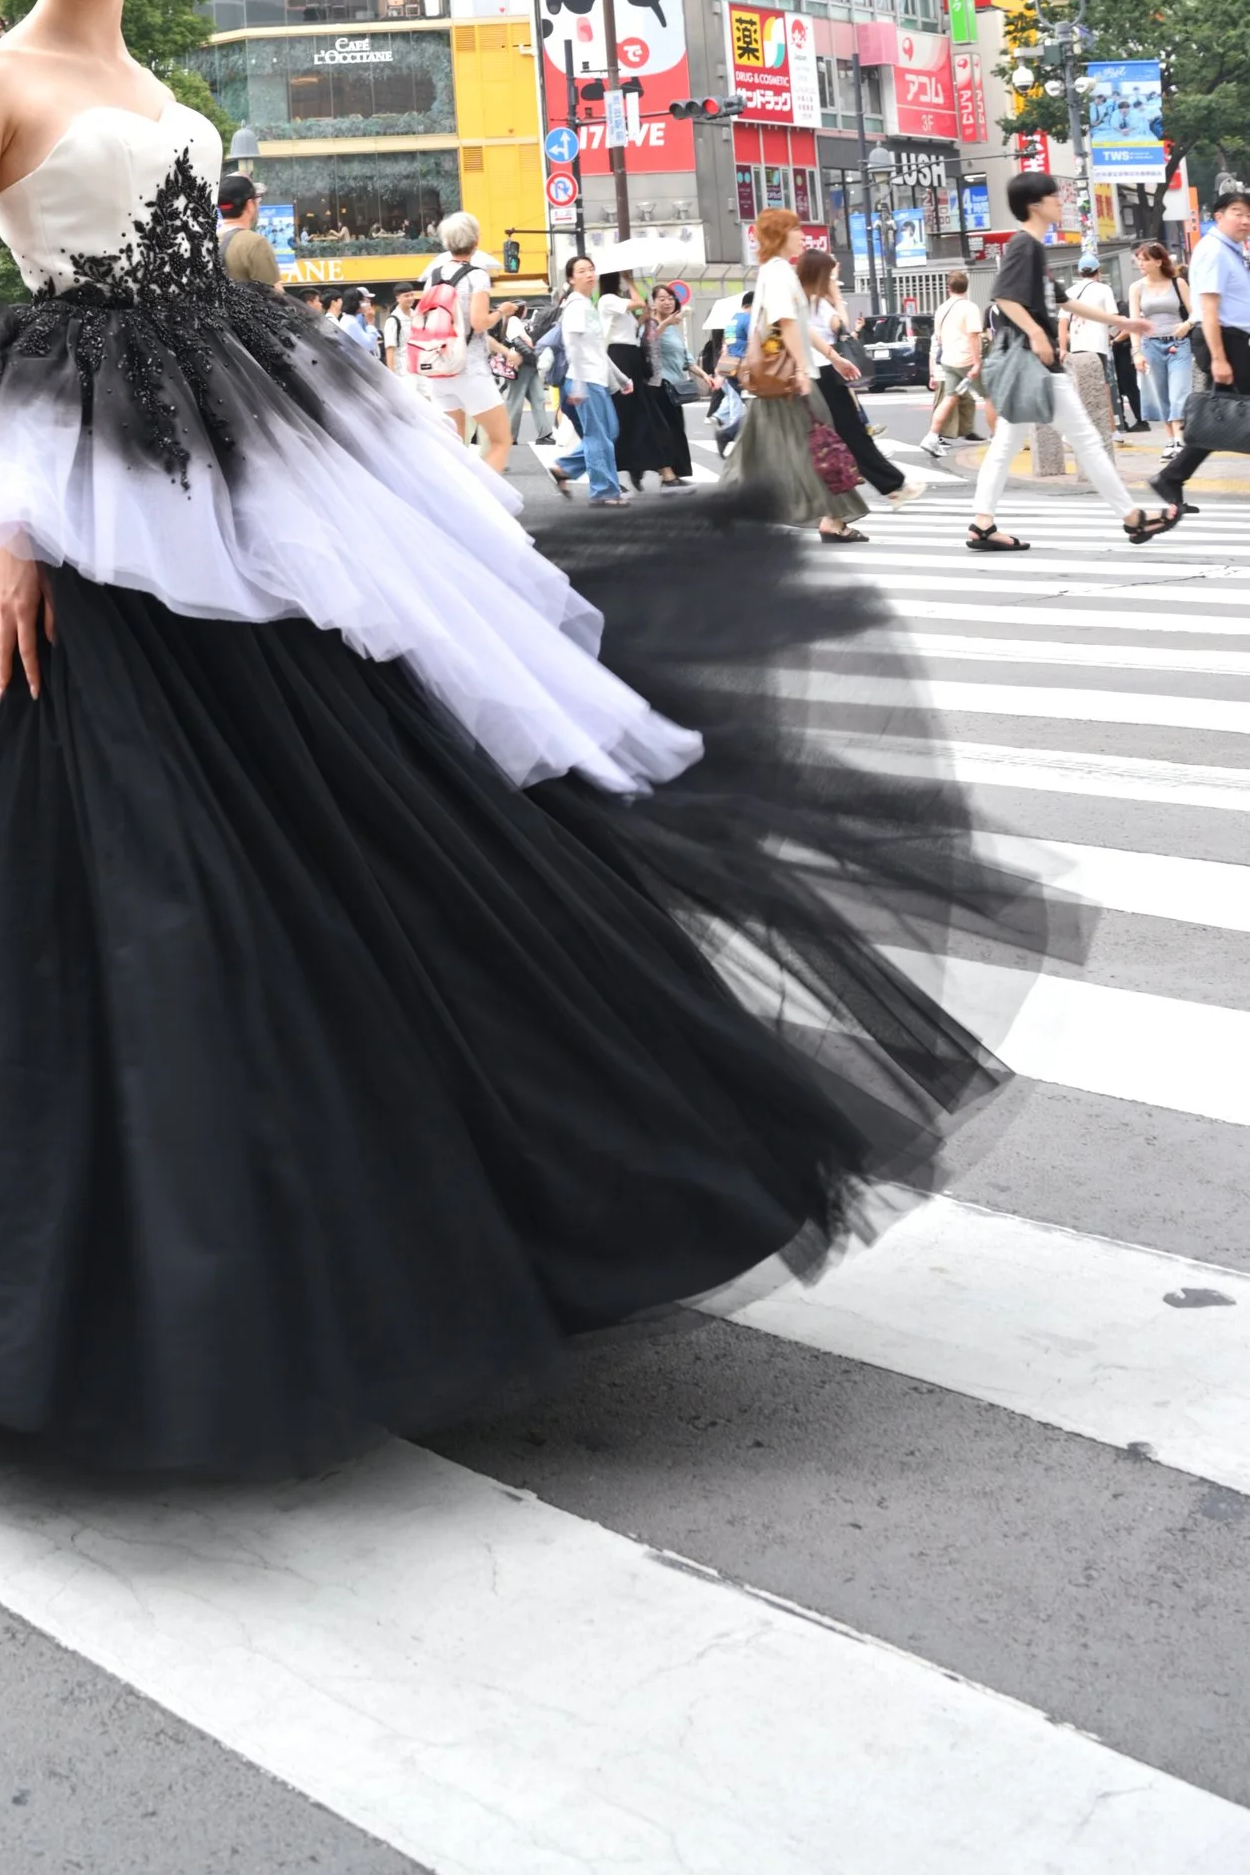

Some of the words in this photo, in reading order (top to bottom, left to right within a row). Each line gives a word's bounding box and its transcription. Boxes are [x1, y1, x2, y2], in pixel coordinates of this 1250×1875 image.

[735, 17, 760, 61] 薬
[314, 49, 393, 65] L'OCCITANE
[735, 71, 753, 83] DRUG
[759, 74, 790, 86] COSMETIC
[905, 73, 944, 105] アコム
[959, 90, 974, 124] アコム
[579, 122, 666, 150] 17VE
[921, 114, 934, 132] 3F
[889, 151, 947, 187] LUSH
[1103, 151, 1130, 161] TWS
